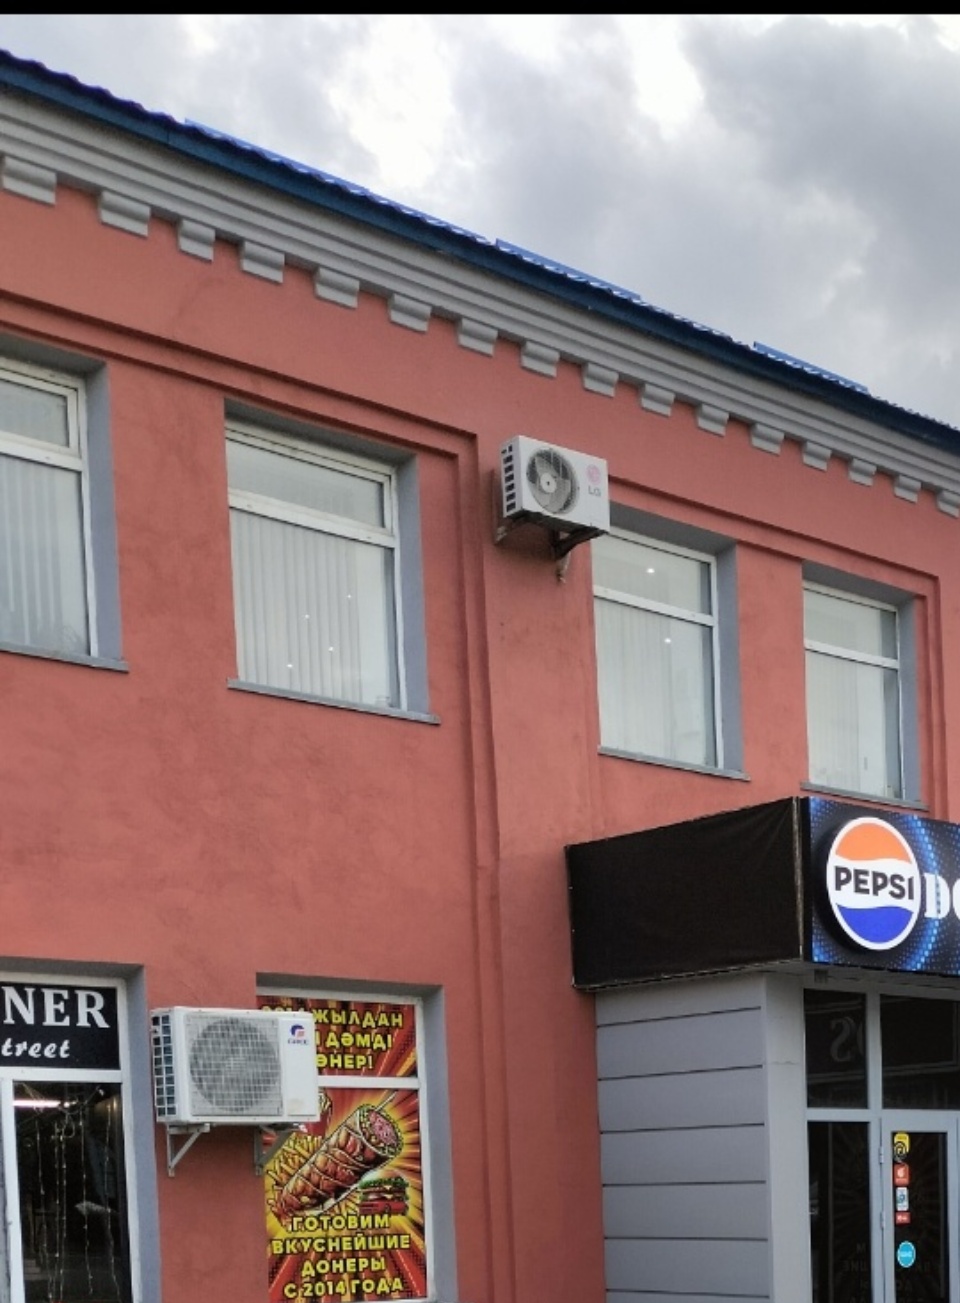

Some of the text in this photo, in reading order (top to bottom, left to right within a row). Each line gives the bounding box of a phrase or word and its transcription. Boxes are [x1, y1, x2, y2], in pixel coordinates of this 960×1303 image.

[588, 485, 602, 497] LG
[834, 865, 915, 901] PEPSI
[1, 986, 110, 1028] NER
[312, 1009, 404, 1028] ЖЫЛДАН
[325, 1032, 393, 1050] ДӘМДІ
[316, 1054, 374, 1070] ӨНЕР!
[292, 1214, 390, 1231] ГОТОВИМ
[271, 1233, 410, 1254] ВКУСНЕЙШИЕ
[301, 1256, 386, 1277] ДОНЕРЫ
[284, 1278, 403, 1298] С 2014 ГОДА
